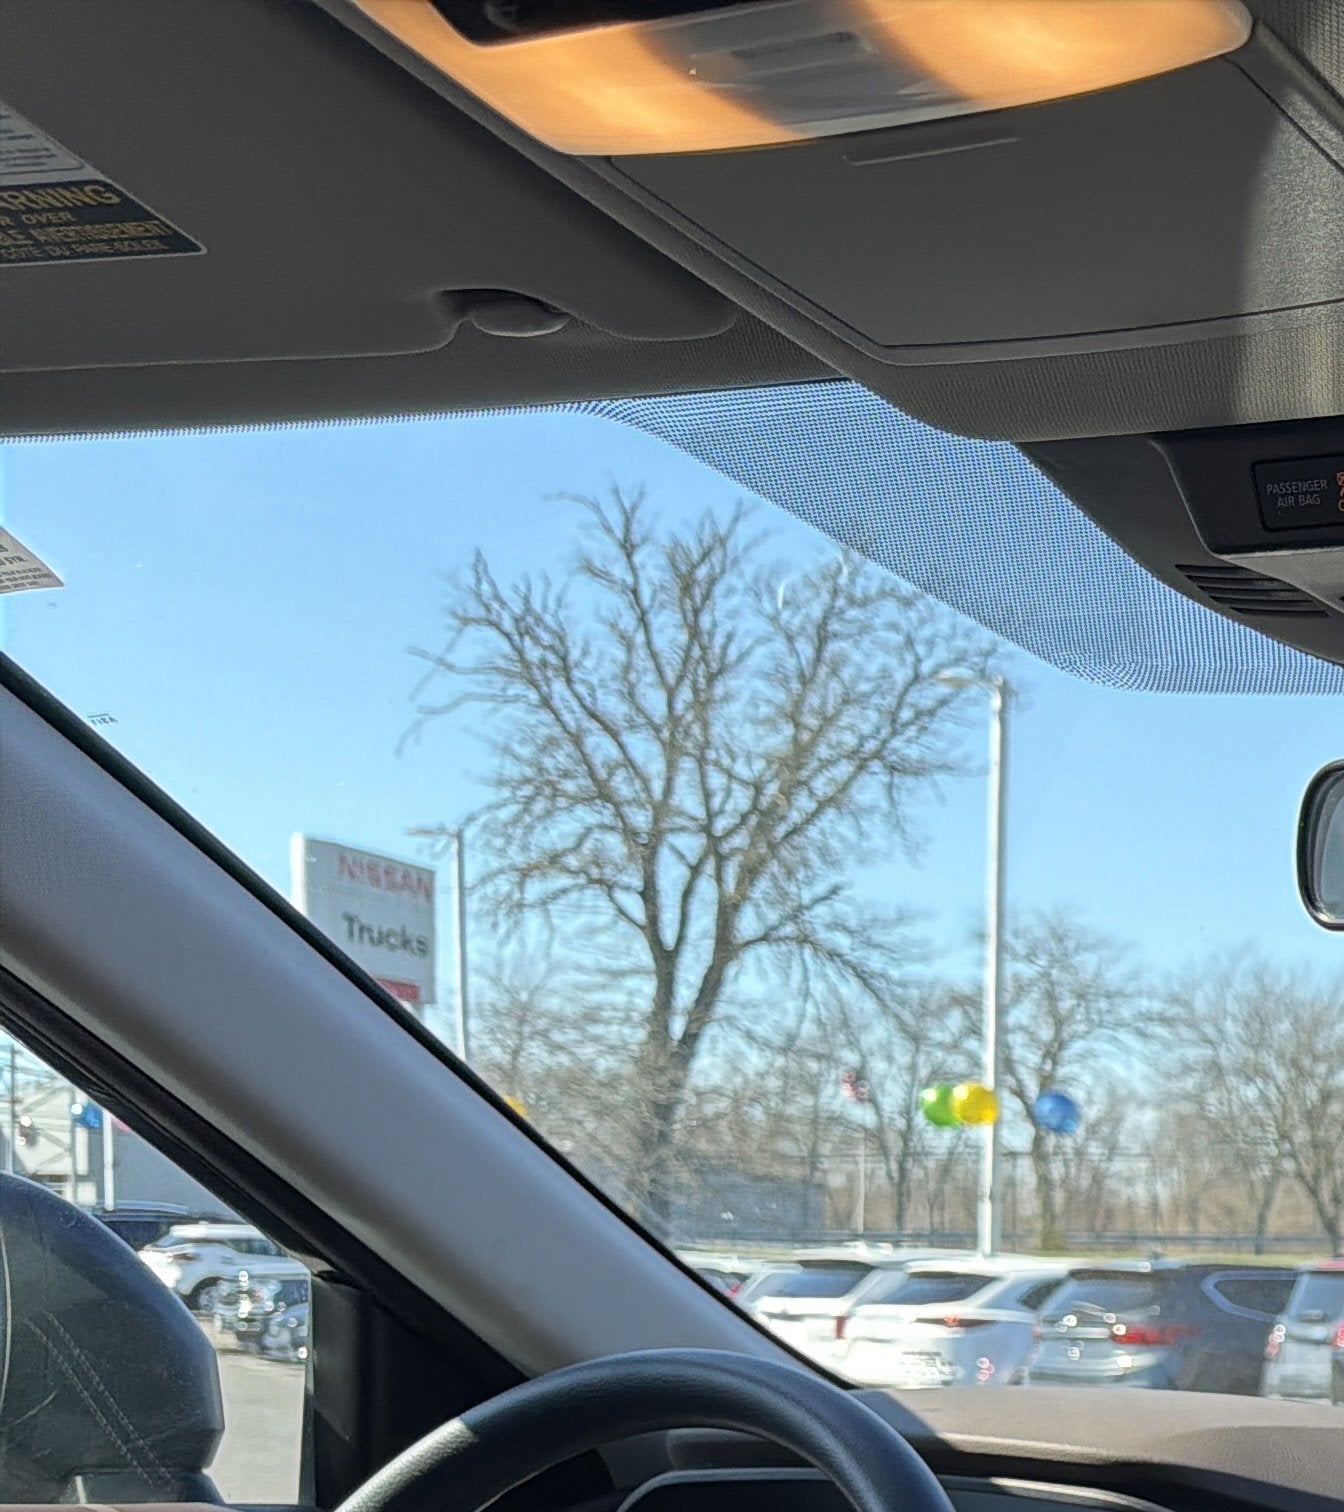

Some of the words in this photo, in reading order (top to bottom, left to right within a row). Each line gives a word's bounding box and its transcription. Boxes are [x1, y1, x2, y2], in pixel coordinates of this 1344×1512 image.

[1266, 480, 1328, 494] PASSENGER
[1277, 495, 1296, 508] AIR
[1299, 493, 1321, 506] BAG
[337, 855, 433, 901] NISSAN
[342, 911, 430, 959] Trucks
